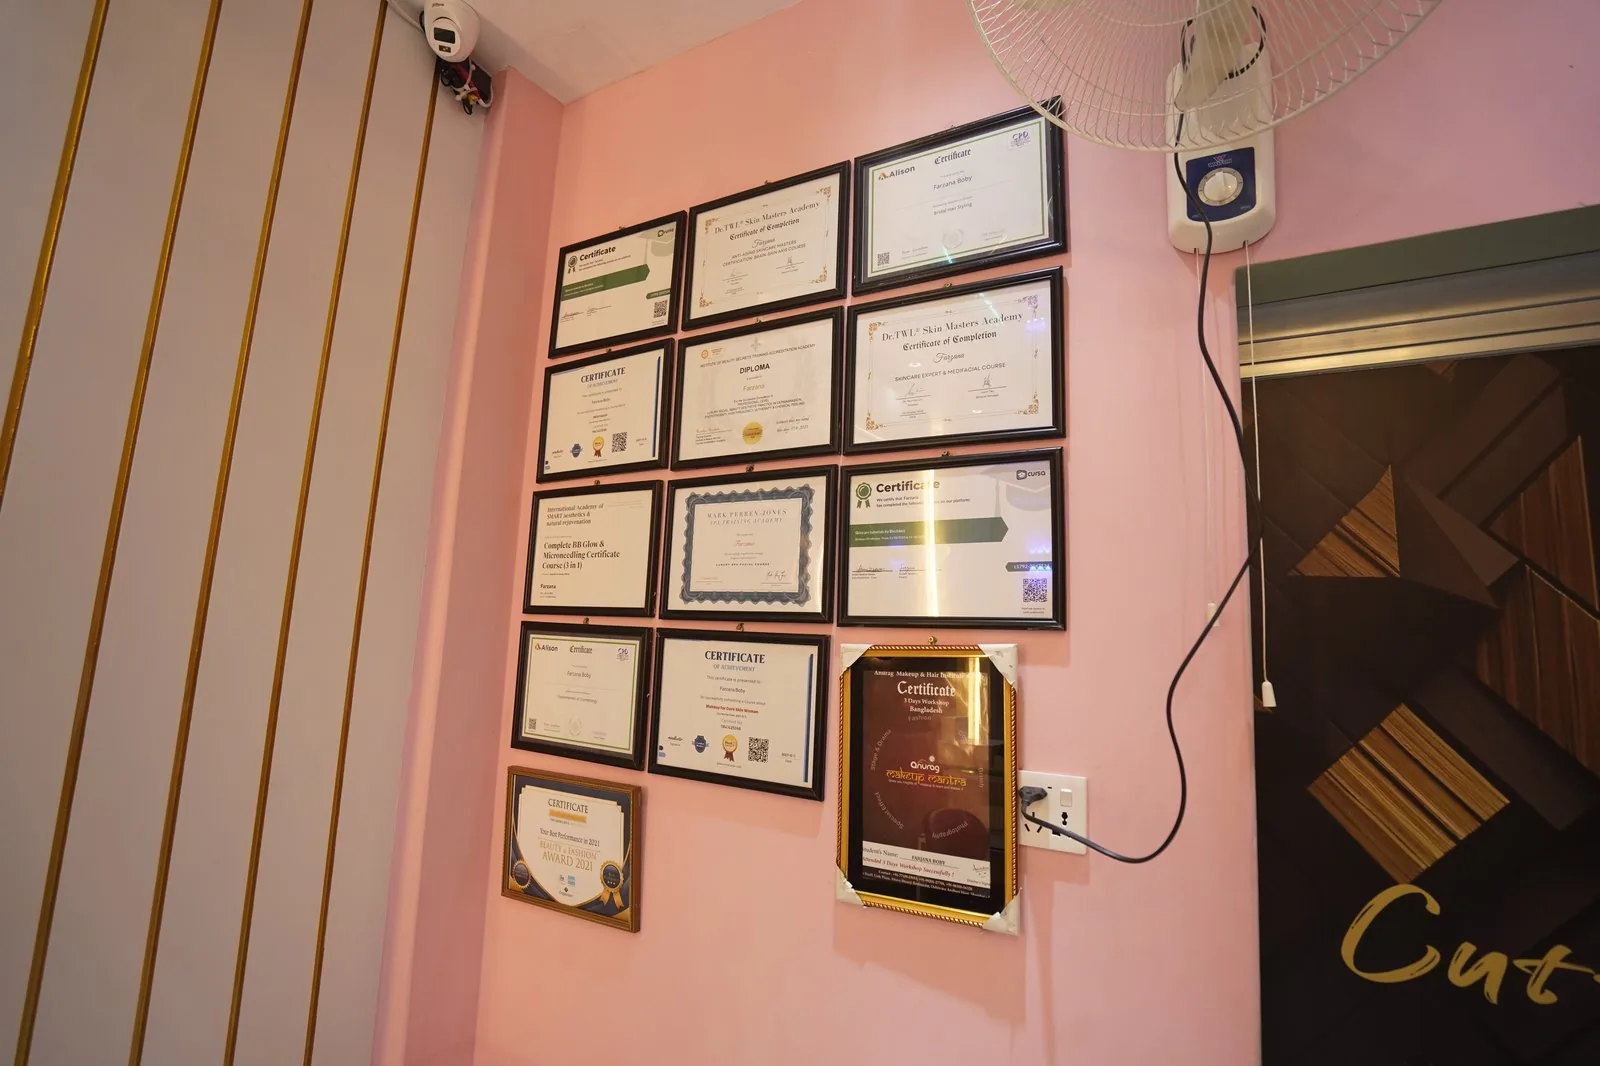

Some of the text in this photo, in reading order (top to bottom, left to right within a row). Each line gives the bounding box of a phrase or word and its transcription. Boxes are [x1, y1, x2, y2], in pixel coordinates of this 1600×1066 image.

[934, 149, 971, 165] Certificate
[889, 165, 916, 178] Alison
[745, 217, 760, 226] Skin
[762, 210, 788, 222] Masters
[790, 202, 820, 214] Academy
[729, 218, 800, 241] Certificate of Completion
[579, 246, 616, 262] Certificate
[922, 323, 943, 334] Skin
[945, 319, 979, 331] Masters
[982, 312, 1024, 326] Academy
[902, 331, 997, 351] Certificate of Completion
[580, 366, 626, 384] CERTIFICATE
[739, 362, 771, 374] DIPLOMA
[895, 373, 921, 382] SKINCARE
[922, 371, 942, 380] EXPERT
[947, 366, 981, 375] MEDIFACIAL
[981, 362, 1006, 371] COURSE
[1027, 469, 1046, 477] cursa
[876, 480, 941, 493] Certificae
[543, 541, 572, 551] Complete
[582, 540, 598, 548] Glow
[543, 549, 620, 560] Microneedling Certificate
[542, 561, 563, 570] Course
[541, 644, 558, 652] Alison
[704, 650, 766, 664] CERTIFICATE
[873, 670, 894, 678] Anurag
[896, 671, 919, 679] Makeup
[897, 680, 957, 697] Certificate
[909, 706, 943, 714] Bangladesh
[921, 699, 950, 707] Workshop
[547, 798, 589, 814] CERTIFICATE
[542, 851, 593, 871] AWARD 2021
